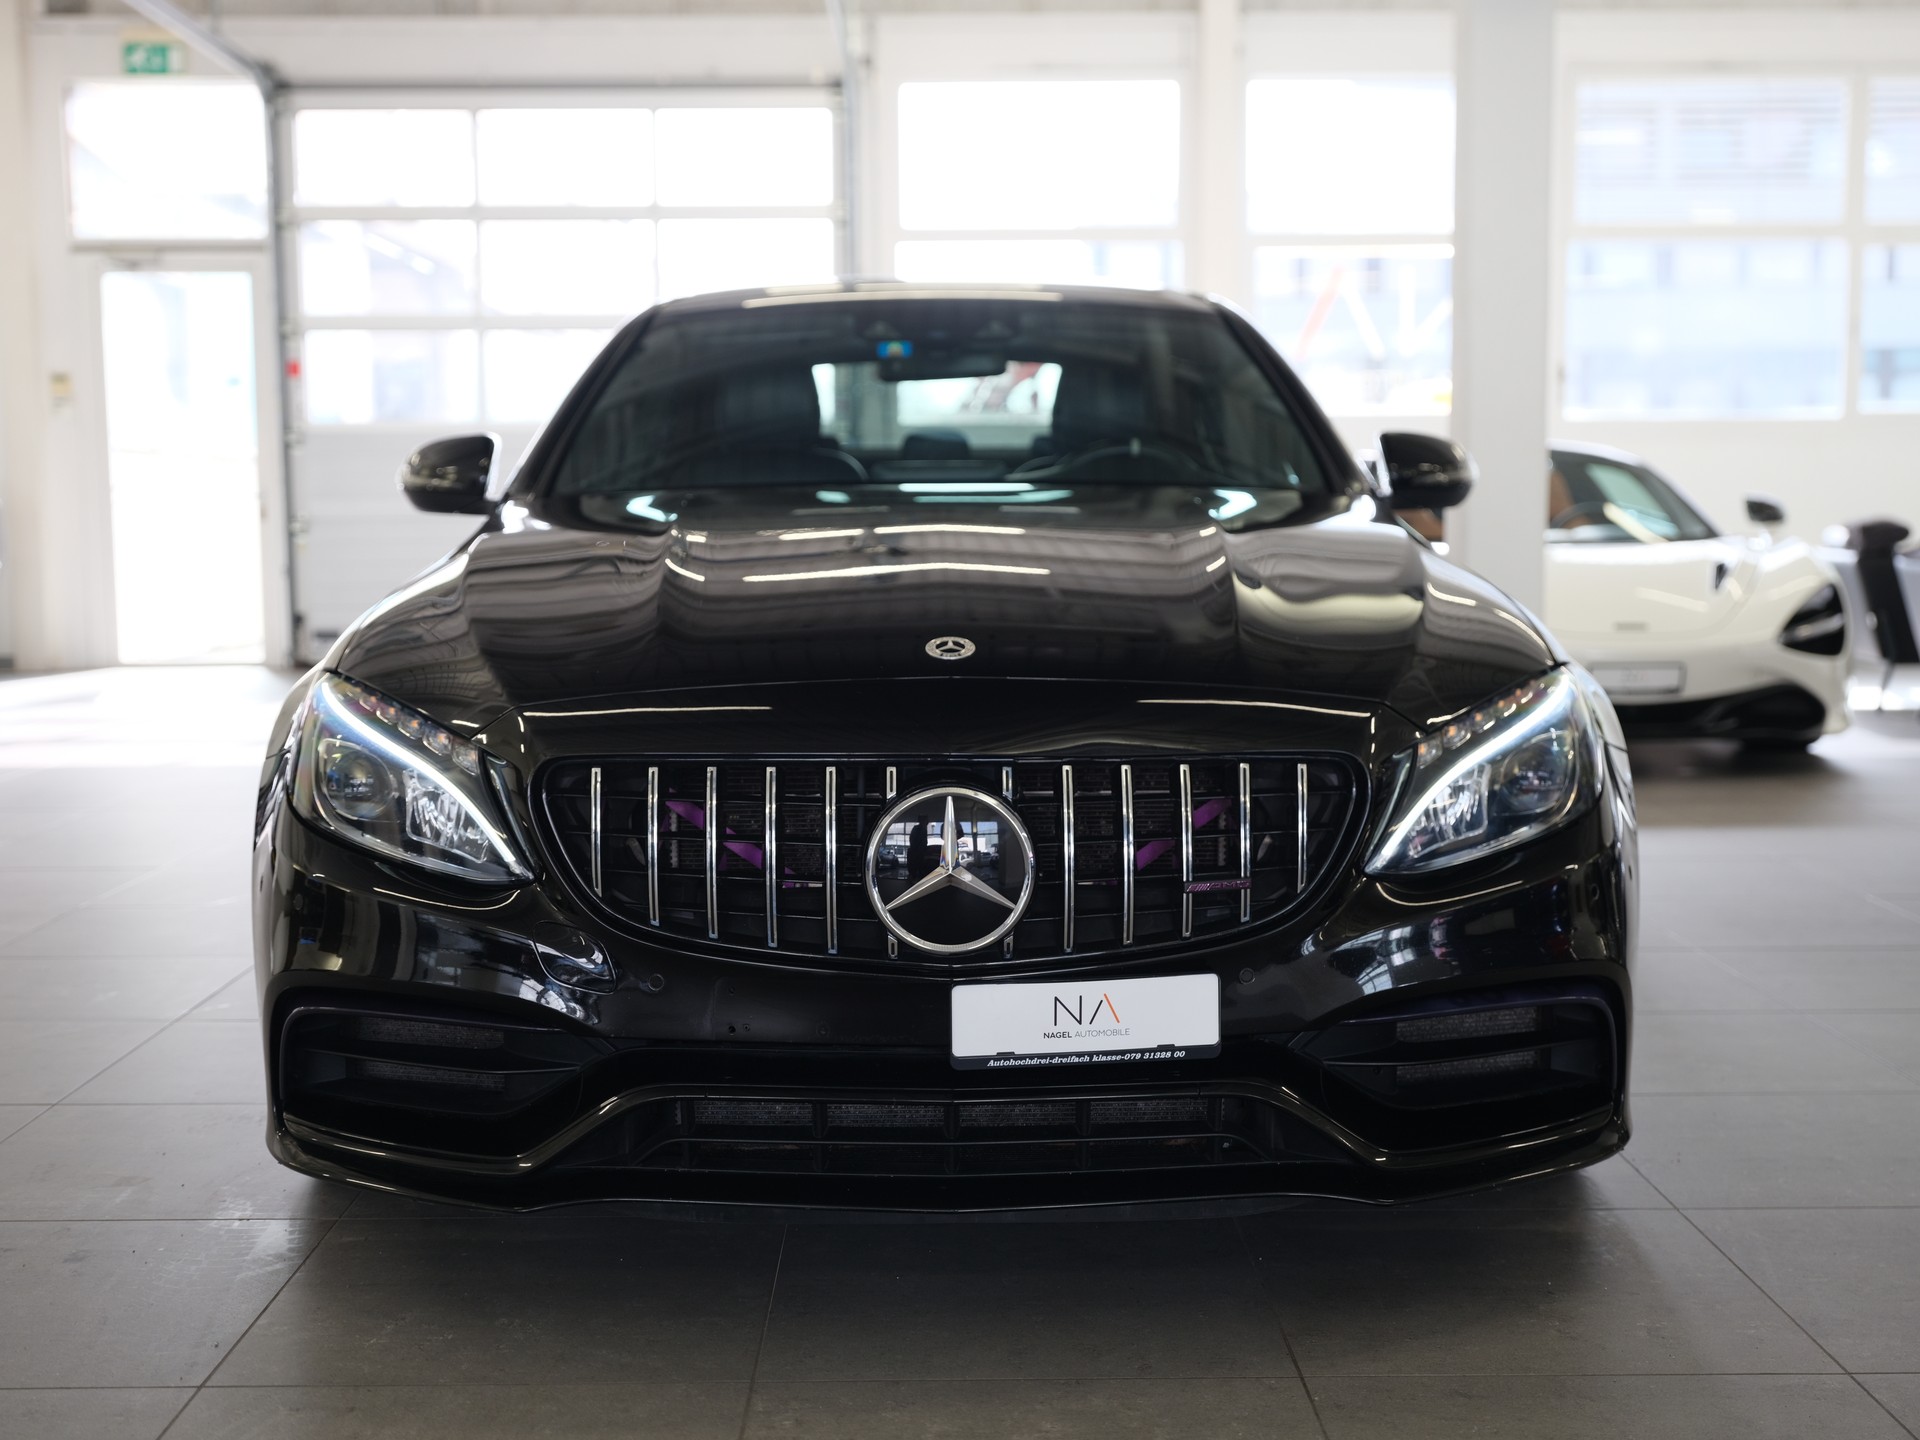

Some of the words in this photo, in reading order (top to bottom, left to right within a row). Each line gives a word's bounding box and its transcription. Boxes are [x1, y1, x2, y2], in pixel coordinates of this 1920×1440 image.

[1043, 1031, 1072, 1039] NAGEL
[1074, 1028, 1131, 1038] AUTOMOBILE
[987, 1055, 1090, 1067] Autohochdrei-dreifach
[1092, 1053, 1141, 1061] klasse-079
[1143, 1051, 1172, 1059] 31328
[1174, 1050, 1186, 1058] 00
